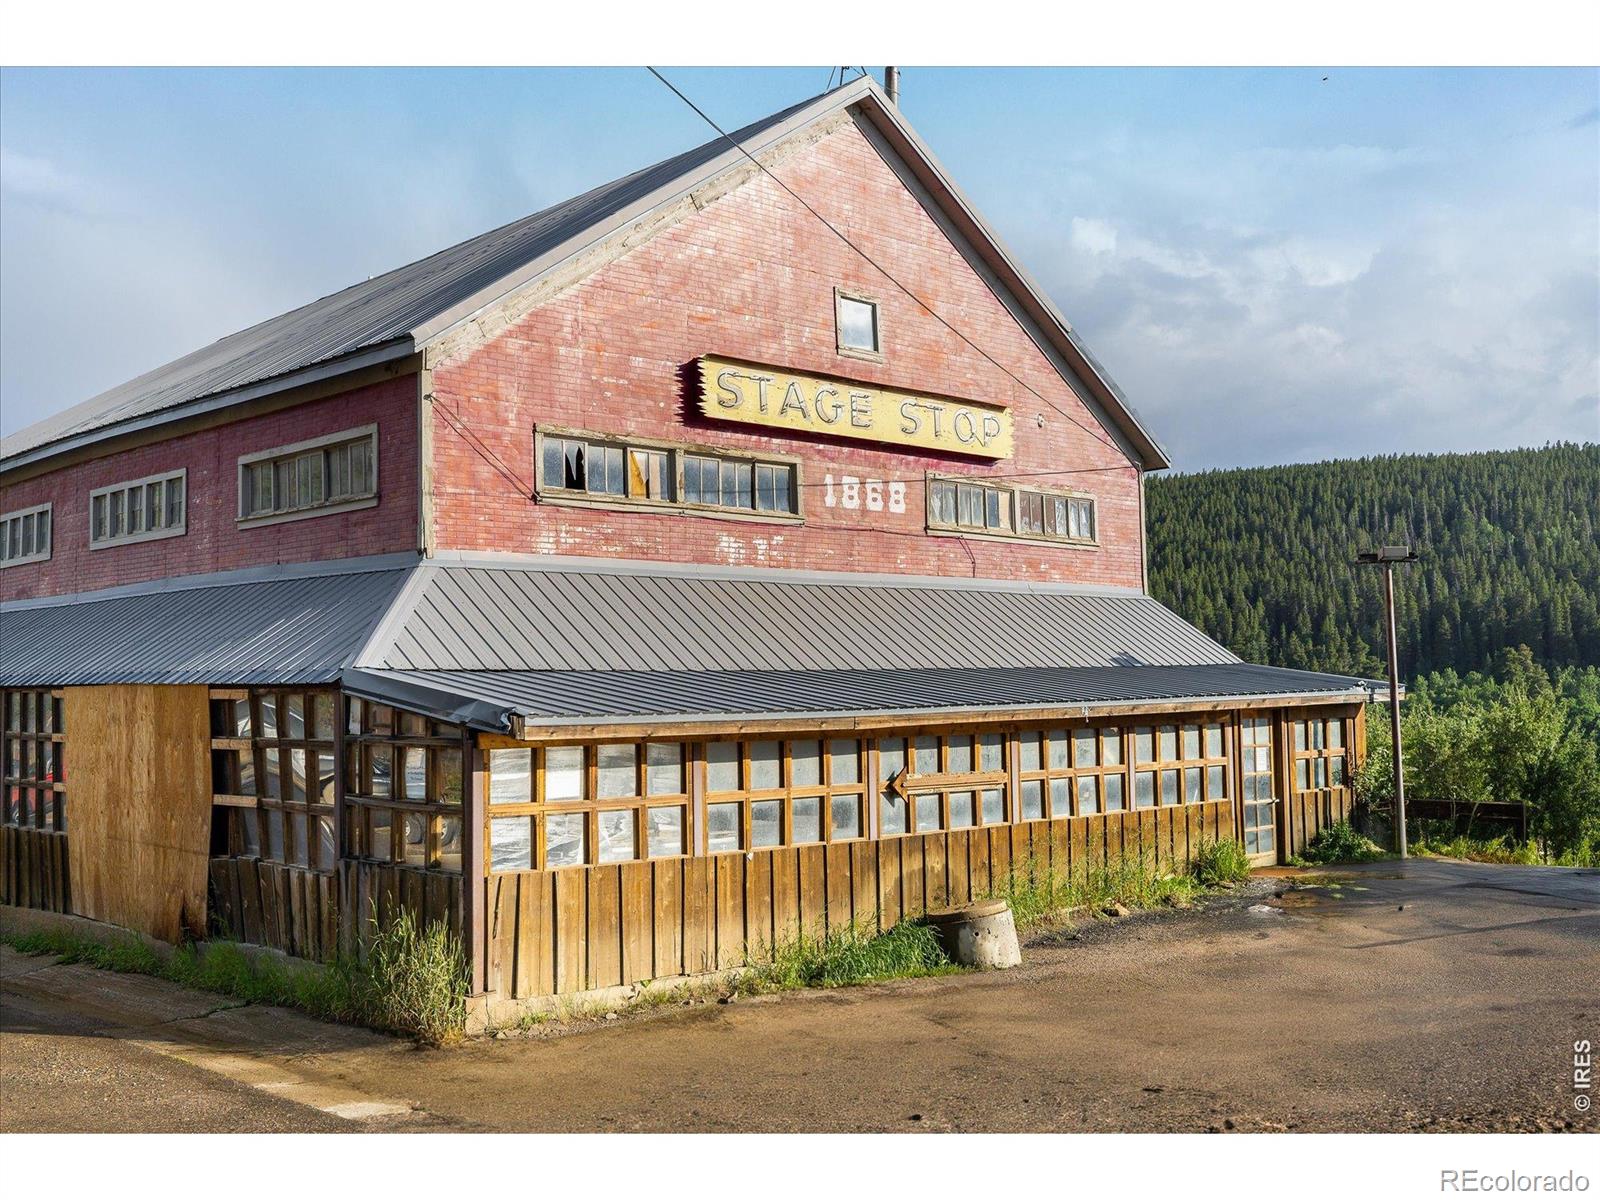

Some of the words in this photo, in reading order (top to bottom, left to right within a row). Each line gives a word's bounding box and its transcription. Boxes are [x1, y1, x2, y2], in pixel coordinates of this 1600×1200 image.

[716, 366, 873, 430] STAGE
[900, 397, 1001, 448] STOP
[824, 474, 906, 514] 1868
